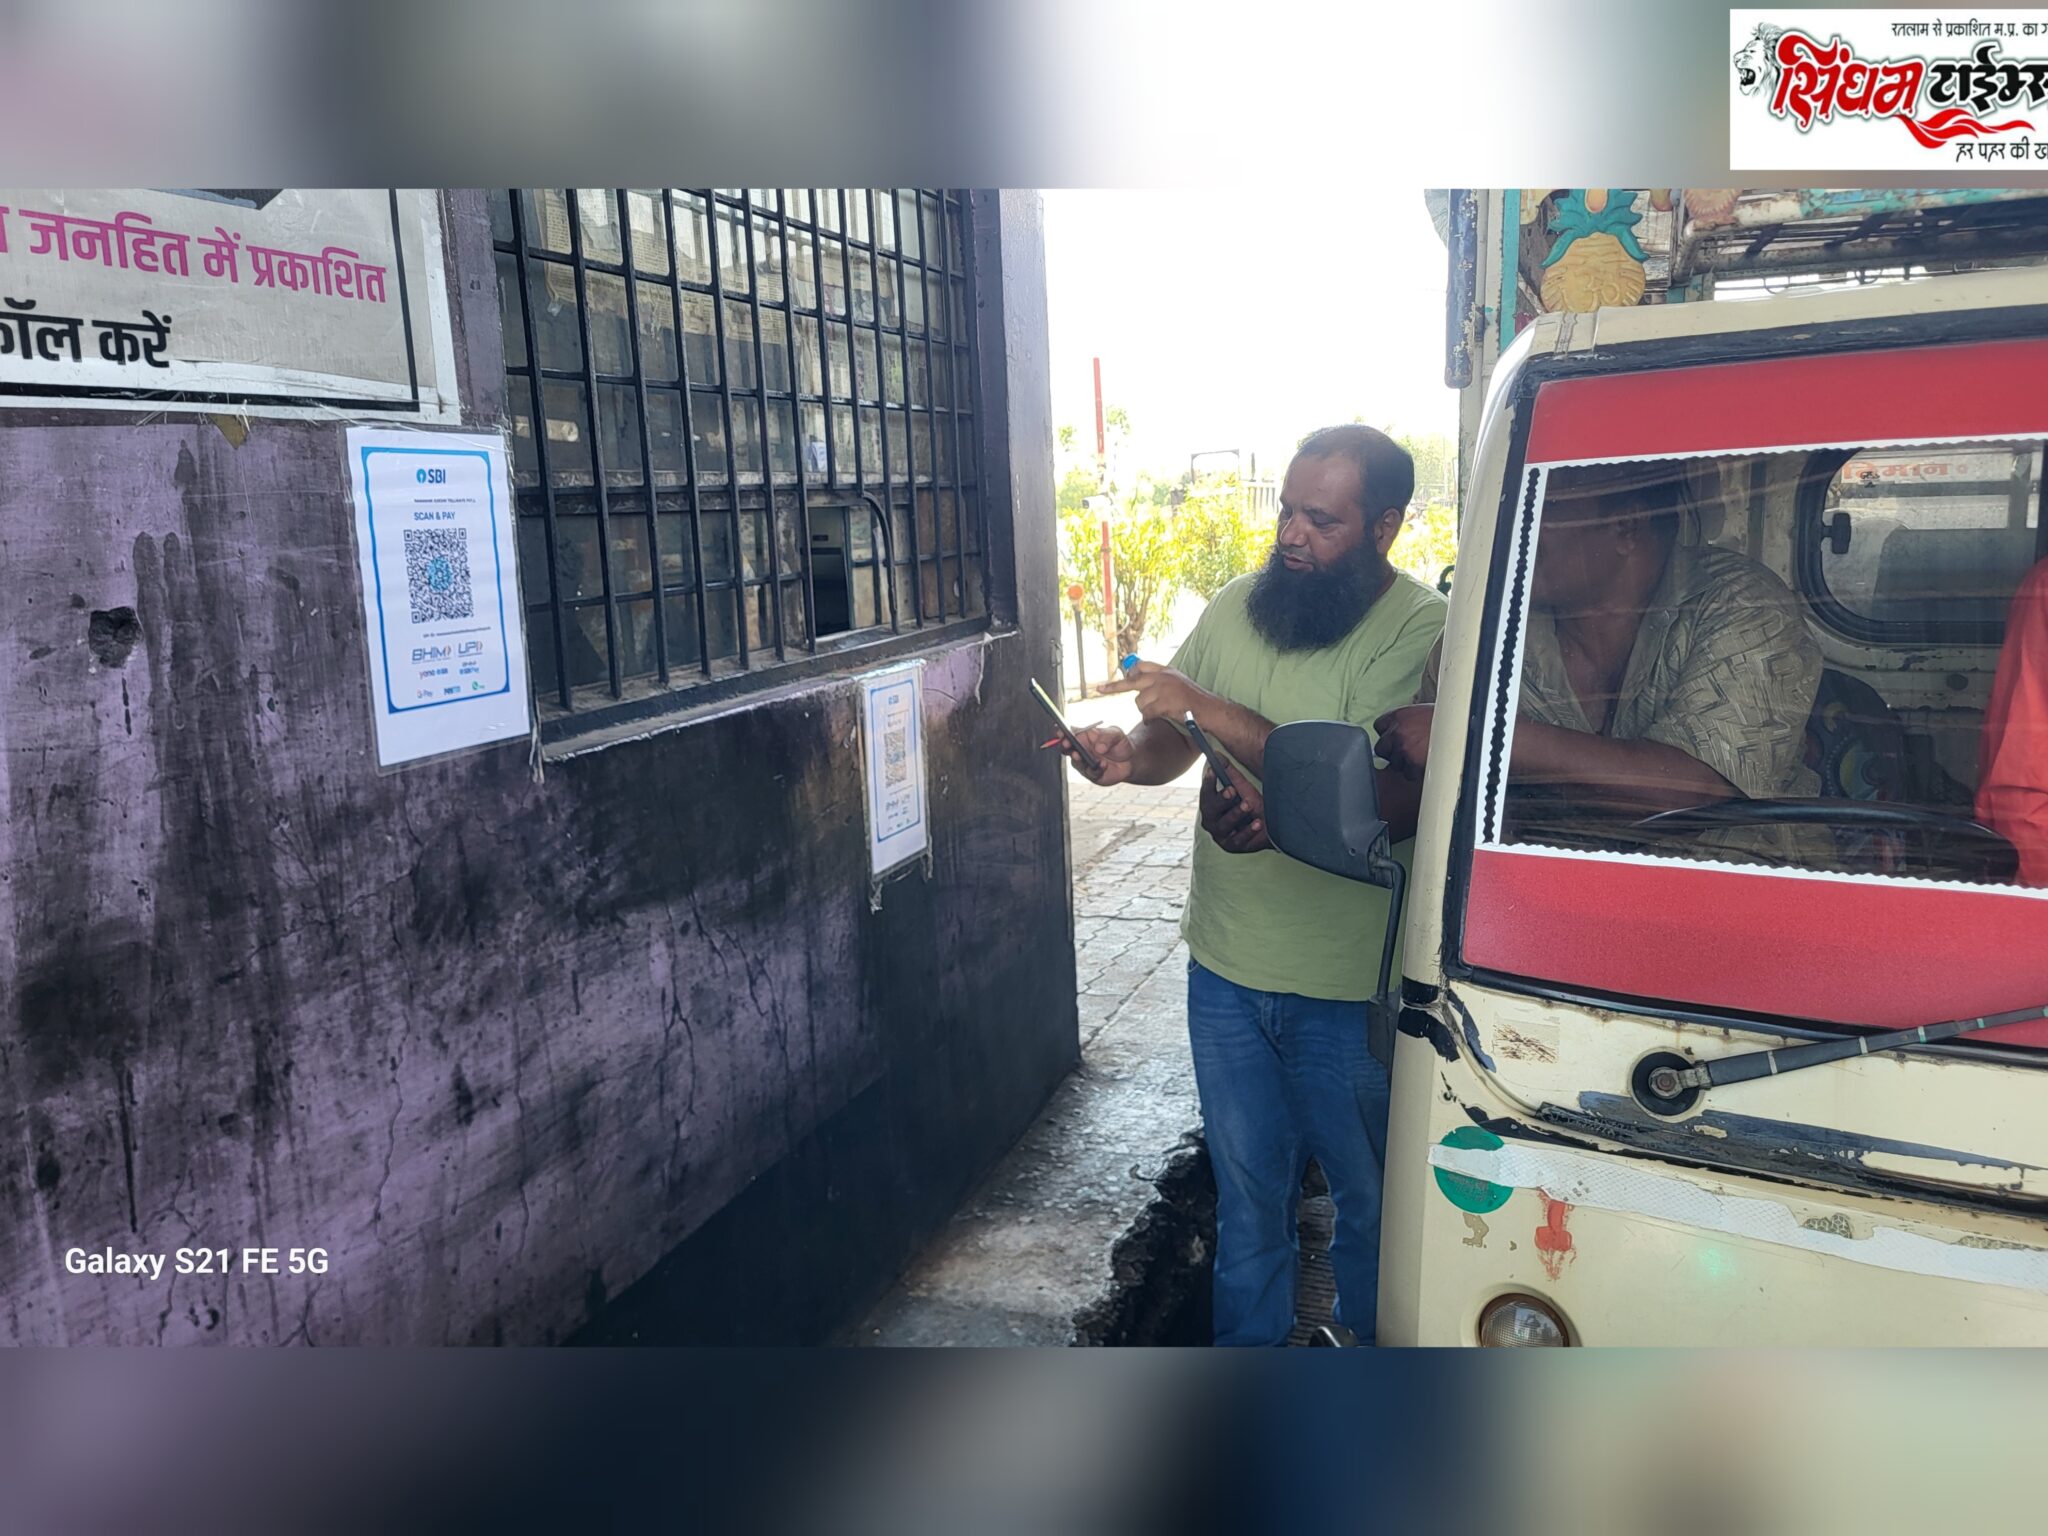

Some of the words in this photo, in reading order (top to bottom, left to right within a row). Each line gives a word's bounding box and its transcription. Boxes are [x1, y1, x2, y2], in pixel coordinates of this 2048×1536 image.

[19, 210, 190, 277] जनहित
[197, 226, 241, 283] में
[246, 244, 387, 304] प्रकाशित
[91, 309, 172, 368] करें
[428, 468, 446, 484] SBI
[414, 511, 434, 521] SCAN
[442, 511, 456, 521] PAY
